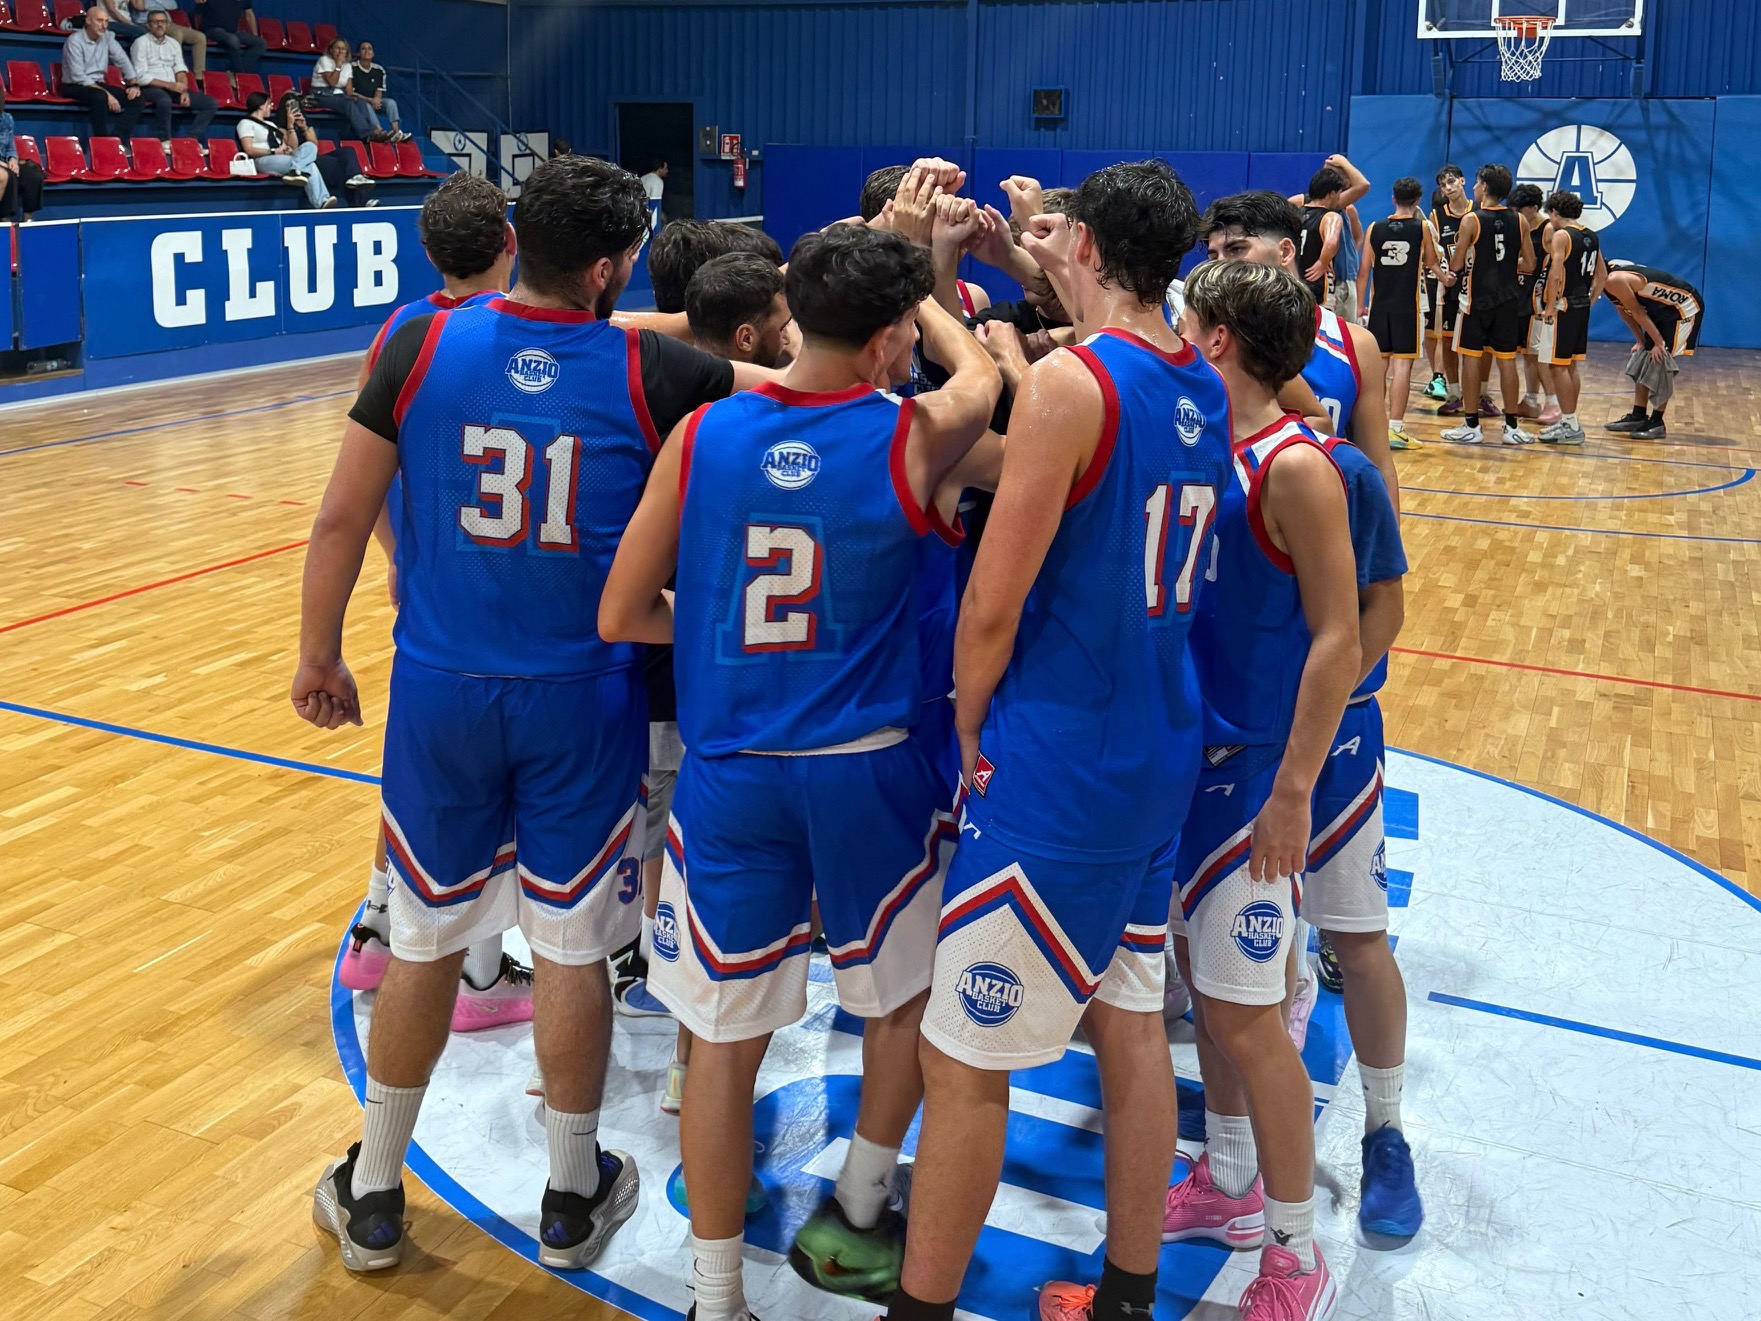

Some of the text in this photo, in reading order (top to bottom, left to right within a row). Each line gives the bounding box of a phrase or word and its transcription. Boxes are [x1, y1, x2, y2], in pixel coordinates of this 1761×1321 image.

[1380, 240, 1411, 266] 3
[1495, 233, 1506, 262] 5
[151, 222, 399, 328] CLUB
[1580, 250, 1598, 277] 14
[1652, 286, 1689, 305] ROMA
[505, 357, 560, 379] ANZIO
[761, 451, 821, 472] ANZIO
[458, 423, 583, 553] 31
[1143, 482, 1217, 617] 17
[742, 522, 824, 654] 2
[1231, 914, 1284, 938] ANZIO
[1248, 931, 1276, 940] BASKET
[955, 970, 1024, 1007] ANZIO
[971, 992, 1008, 1007] BASKET
[976, 1001, 1001, 1013] CLUB
